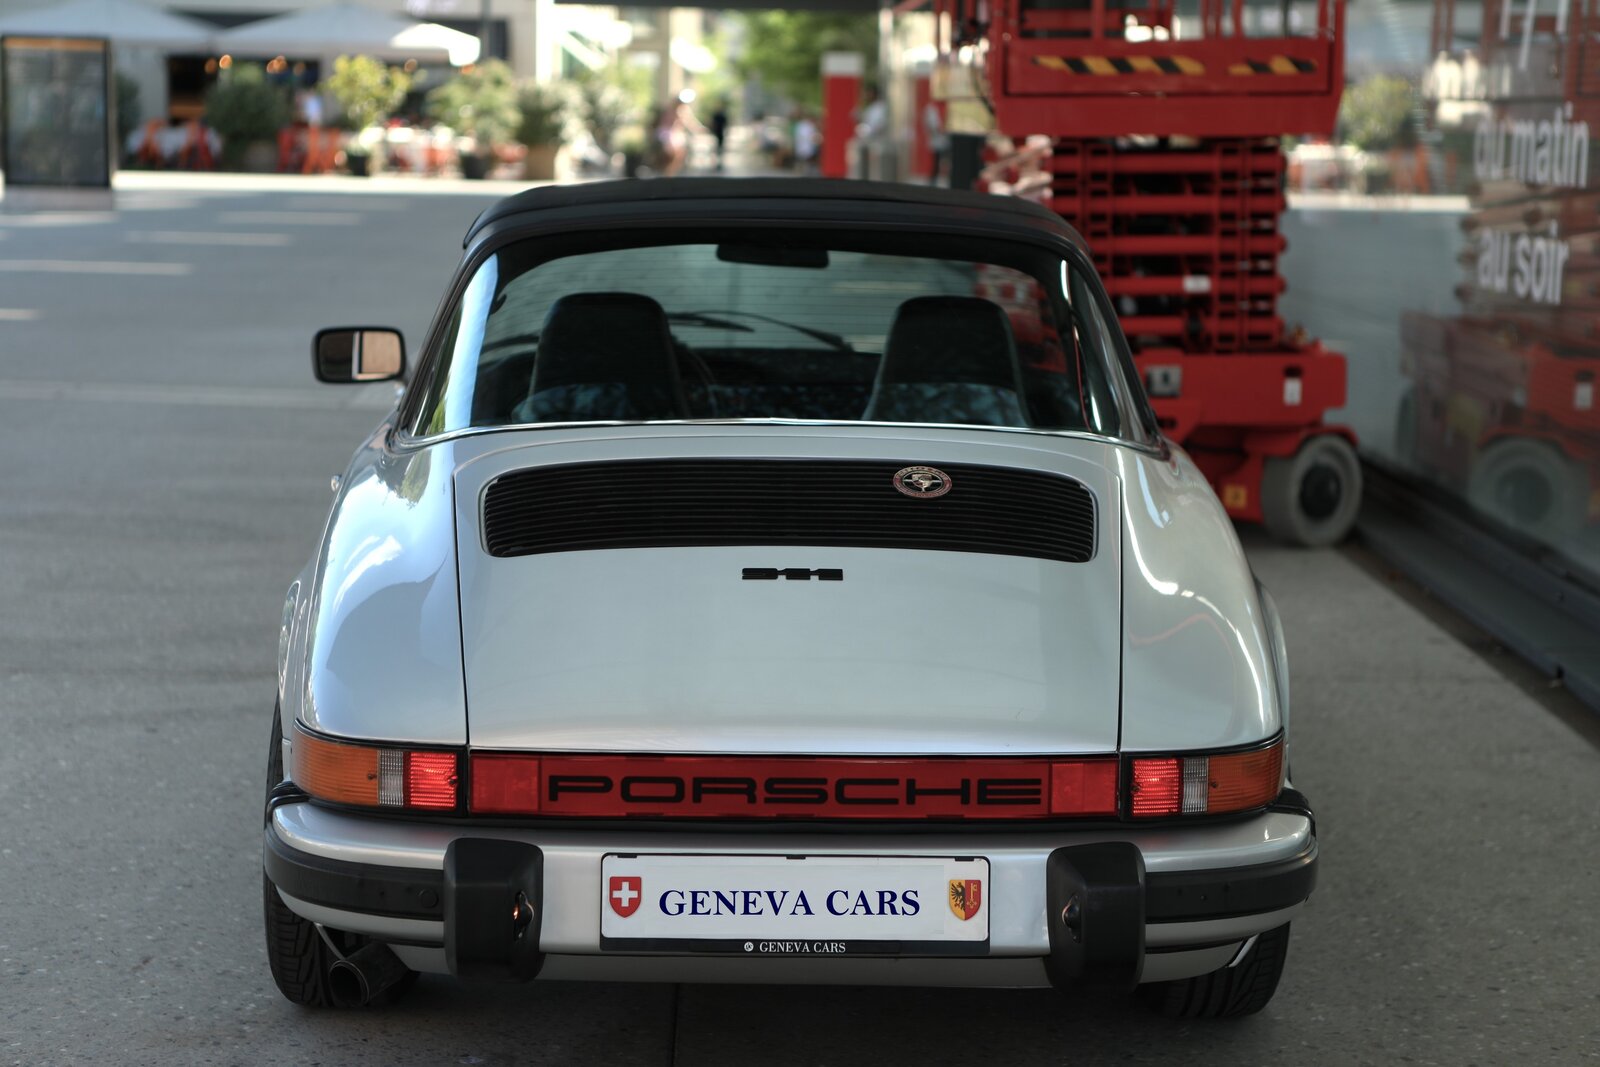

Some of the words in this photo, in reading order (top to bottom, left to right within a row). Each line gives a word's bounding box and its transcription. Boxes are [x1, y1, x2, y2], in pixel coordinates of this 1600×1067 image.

[1474, 106, 1505, 181] du
[1510, 101, 1590, 189] matin
[1478, 227, 1510, 294] au
[1514, 219, 1570, 305] soir
[548, 775, 1042, 806] PORSCHE
[658, 889, 816, 917] GENEVA
[825, 889, 921, 917] CARS
[759, 941, 811, 953] GENEVA
[813, 942, 846, 954] CARS
